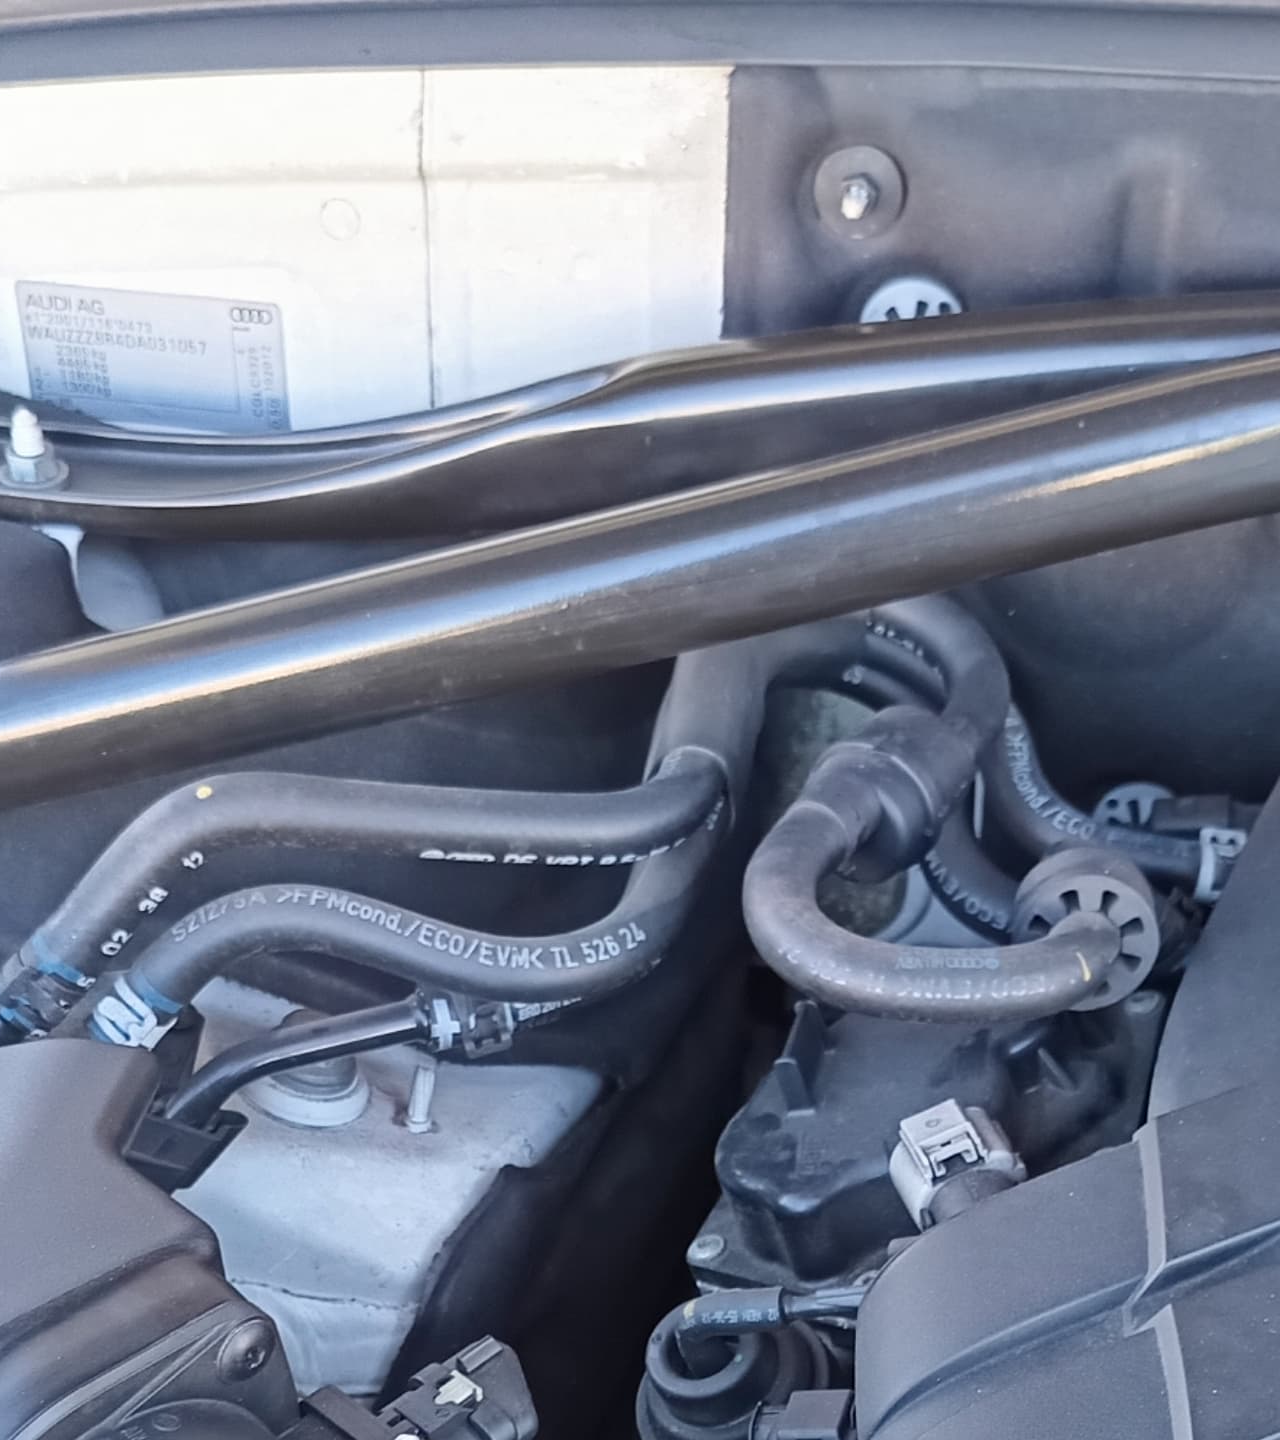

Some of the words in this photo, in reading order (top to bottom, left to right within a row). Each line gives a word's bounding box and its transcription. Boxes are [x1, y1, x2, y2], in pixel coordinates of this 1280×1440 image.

[25, 293, 71, 311] AUDI
[77, 298, 105, 315] AG
[550, 946, 579, 969] TL
[580, 935, 621, 964] 526
[619, 922, 647, 949] 24
